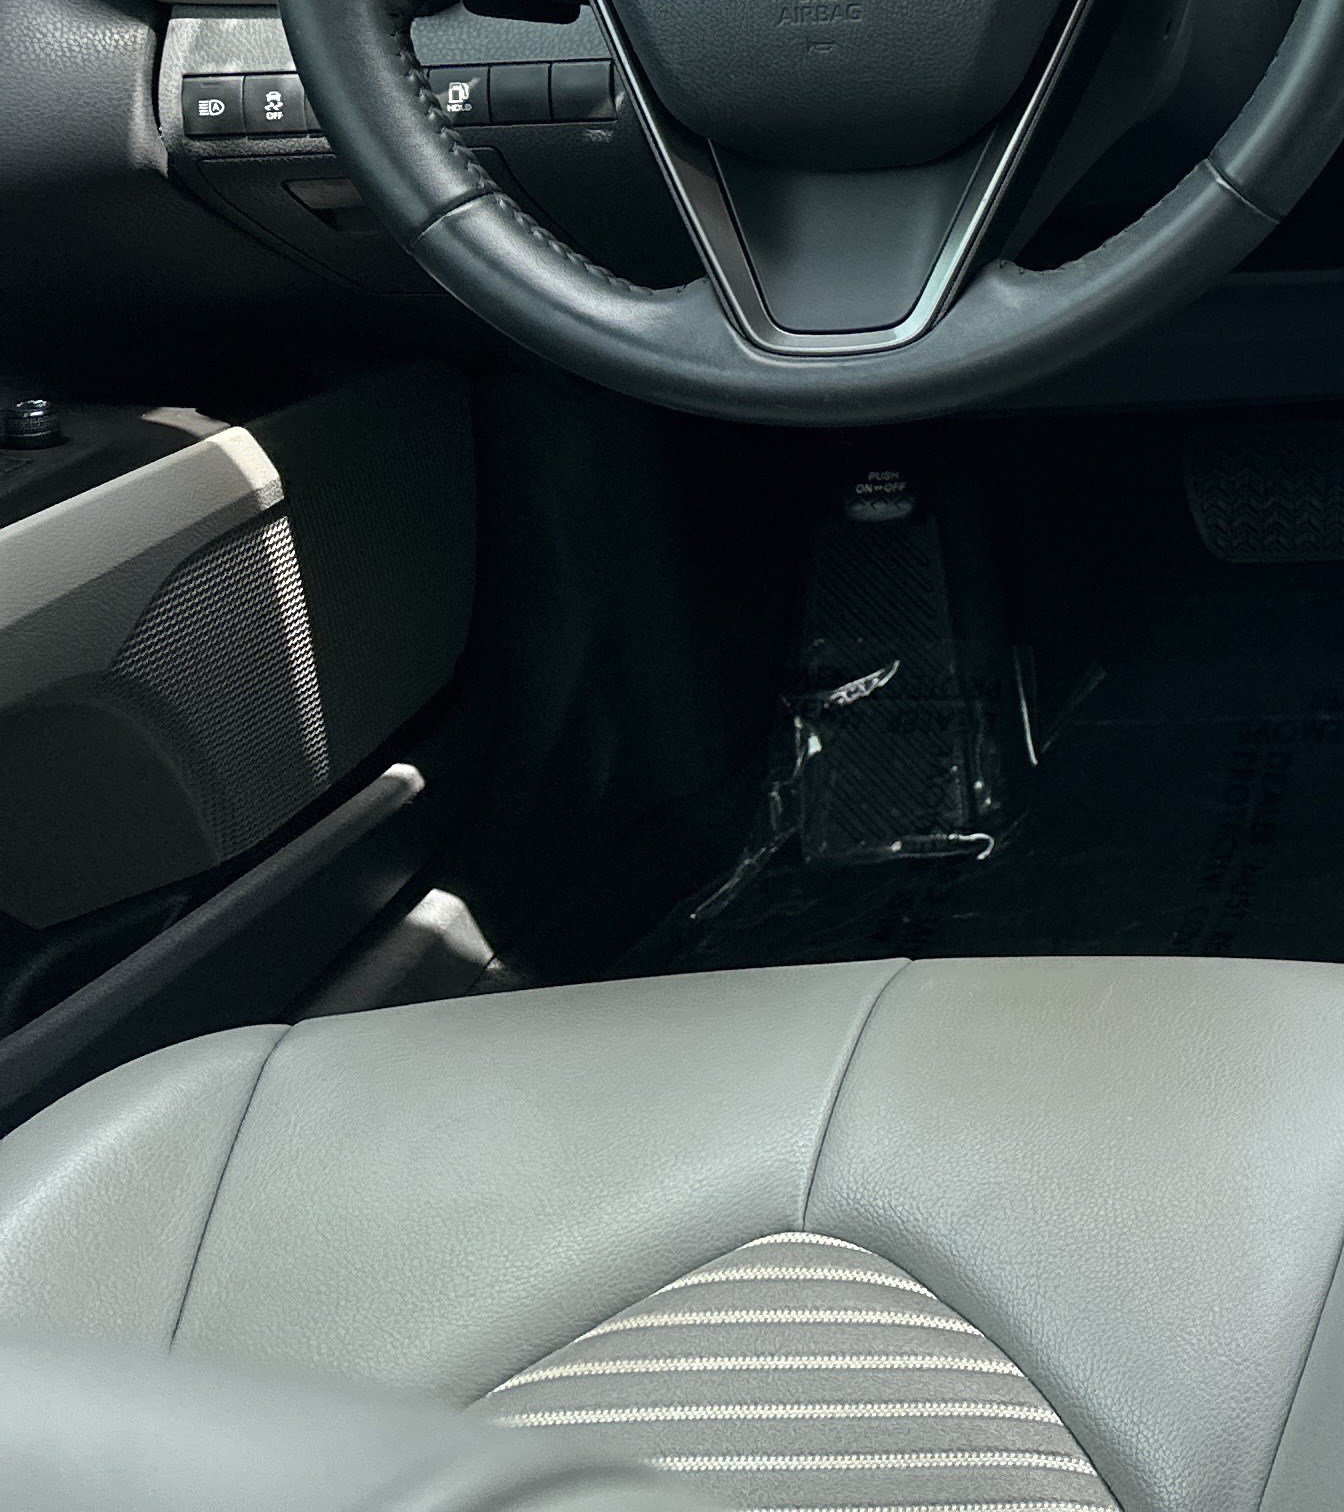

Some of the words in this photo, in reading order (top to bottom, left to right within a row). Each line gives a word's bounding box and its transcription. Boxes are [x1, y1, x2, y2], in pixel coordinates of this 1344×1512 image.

[775, 2, 863, 27] AIRBAG
[265, 111, 283, 120] OFF
[868, 471, 899, 481] PUSH
